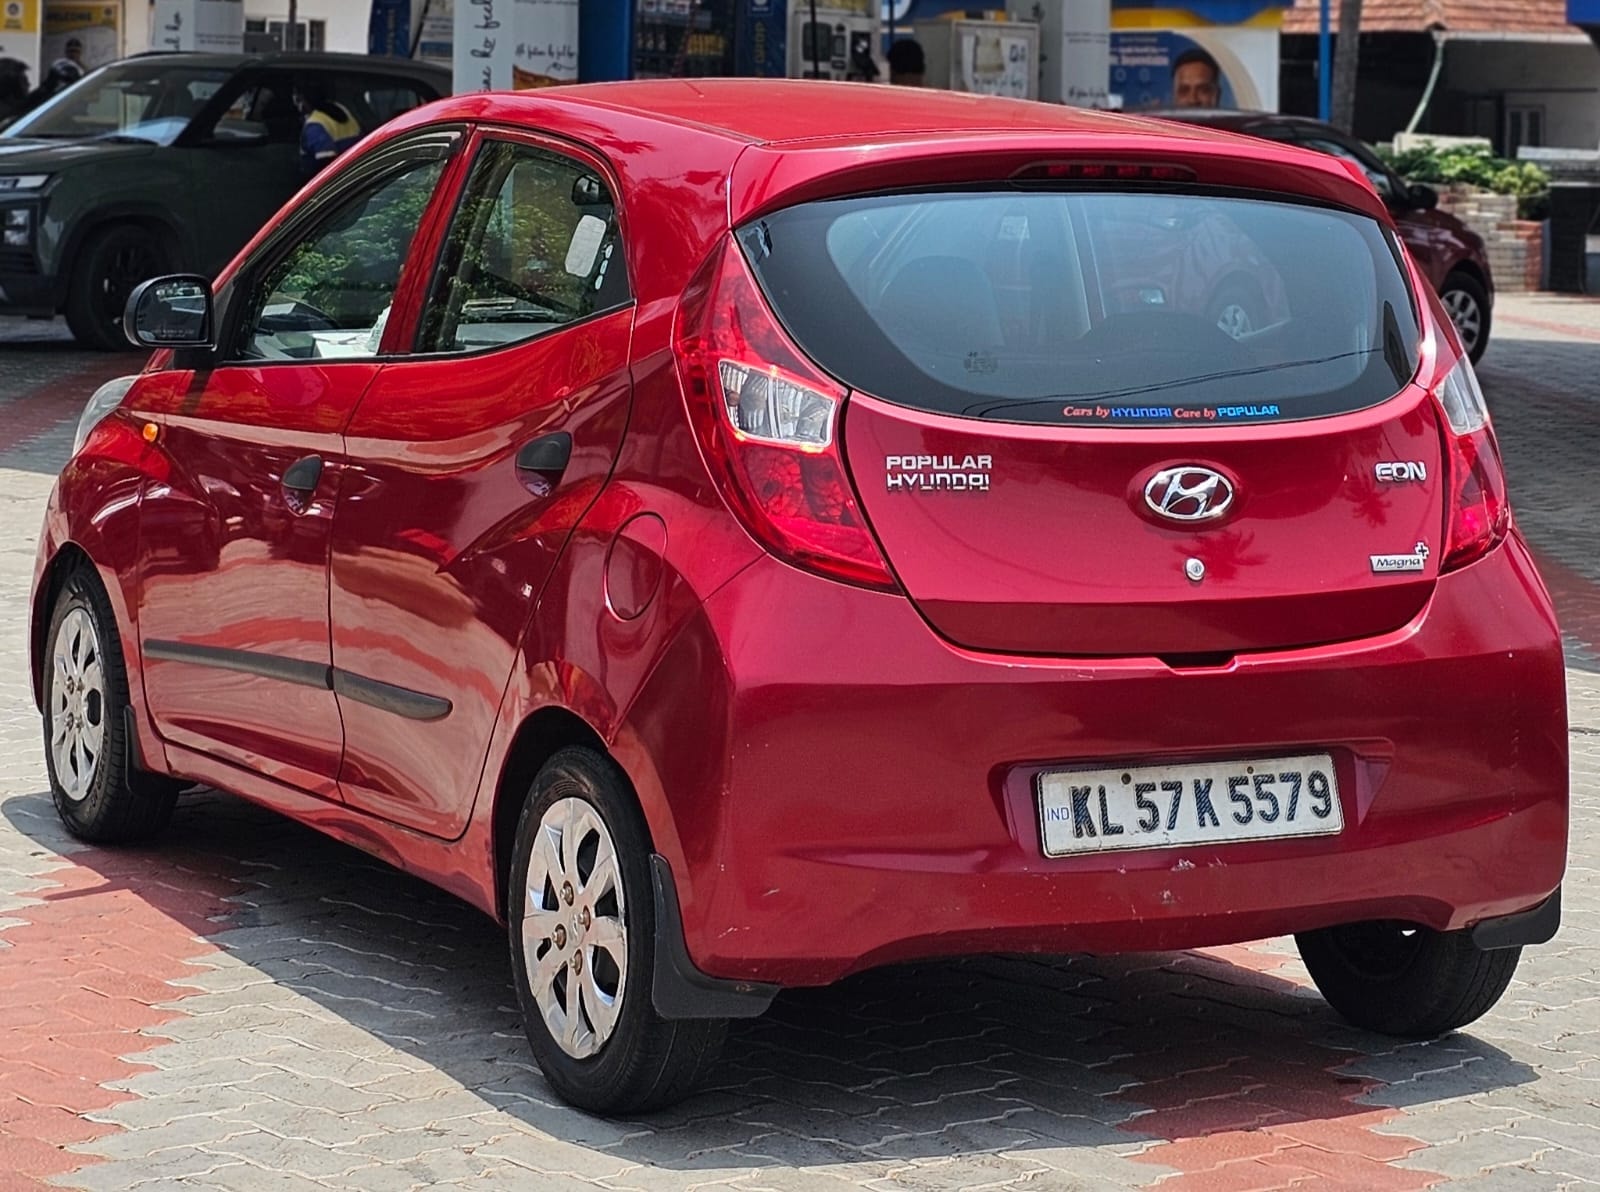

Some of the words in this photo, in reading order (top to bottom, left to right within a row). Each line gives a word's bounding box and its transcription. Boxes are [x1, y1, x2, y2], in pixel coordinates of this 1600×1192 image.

[1063, 406, 1093, 417] Cars
[1095, 406, 1110, 418] by
[1111, 408, 1172, 418] HYUNDAI
[1174, 408, 1201, 418] Care
[1203, 408, 1217, 419] by
[1217, 405, 1280, 417] POPULAR
[886, 454, 993, 470] POPULAR
[1375, 461, 1427, 481] EON
[886, 472, 990, 491] HYUNDAI
[1047, 806, 1070, 822] IND
[1070, 785, 1124, 839] KL
[1135, 780, 1183, 834] 57
[1193, 778, 1220, 828] K
[1227, 769, 1333, 825] 5579
